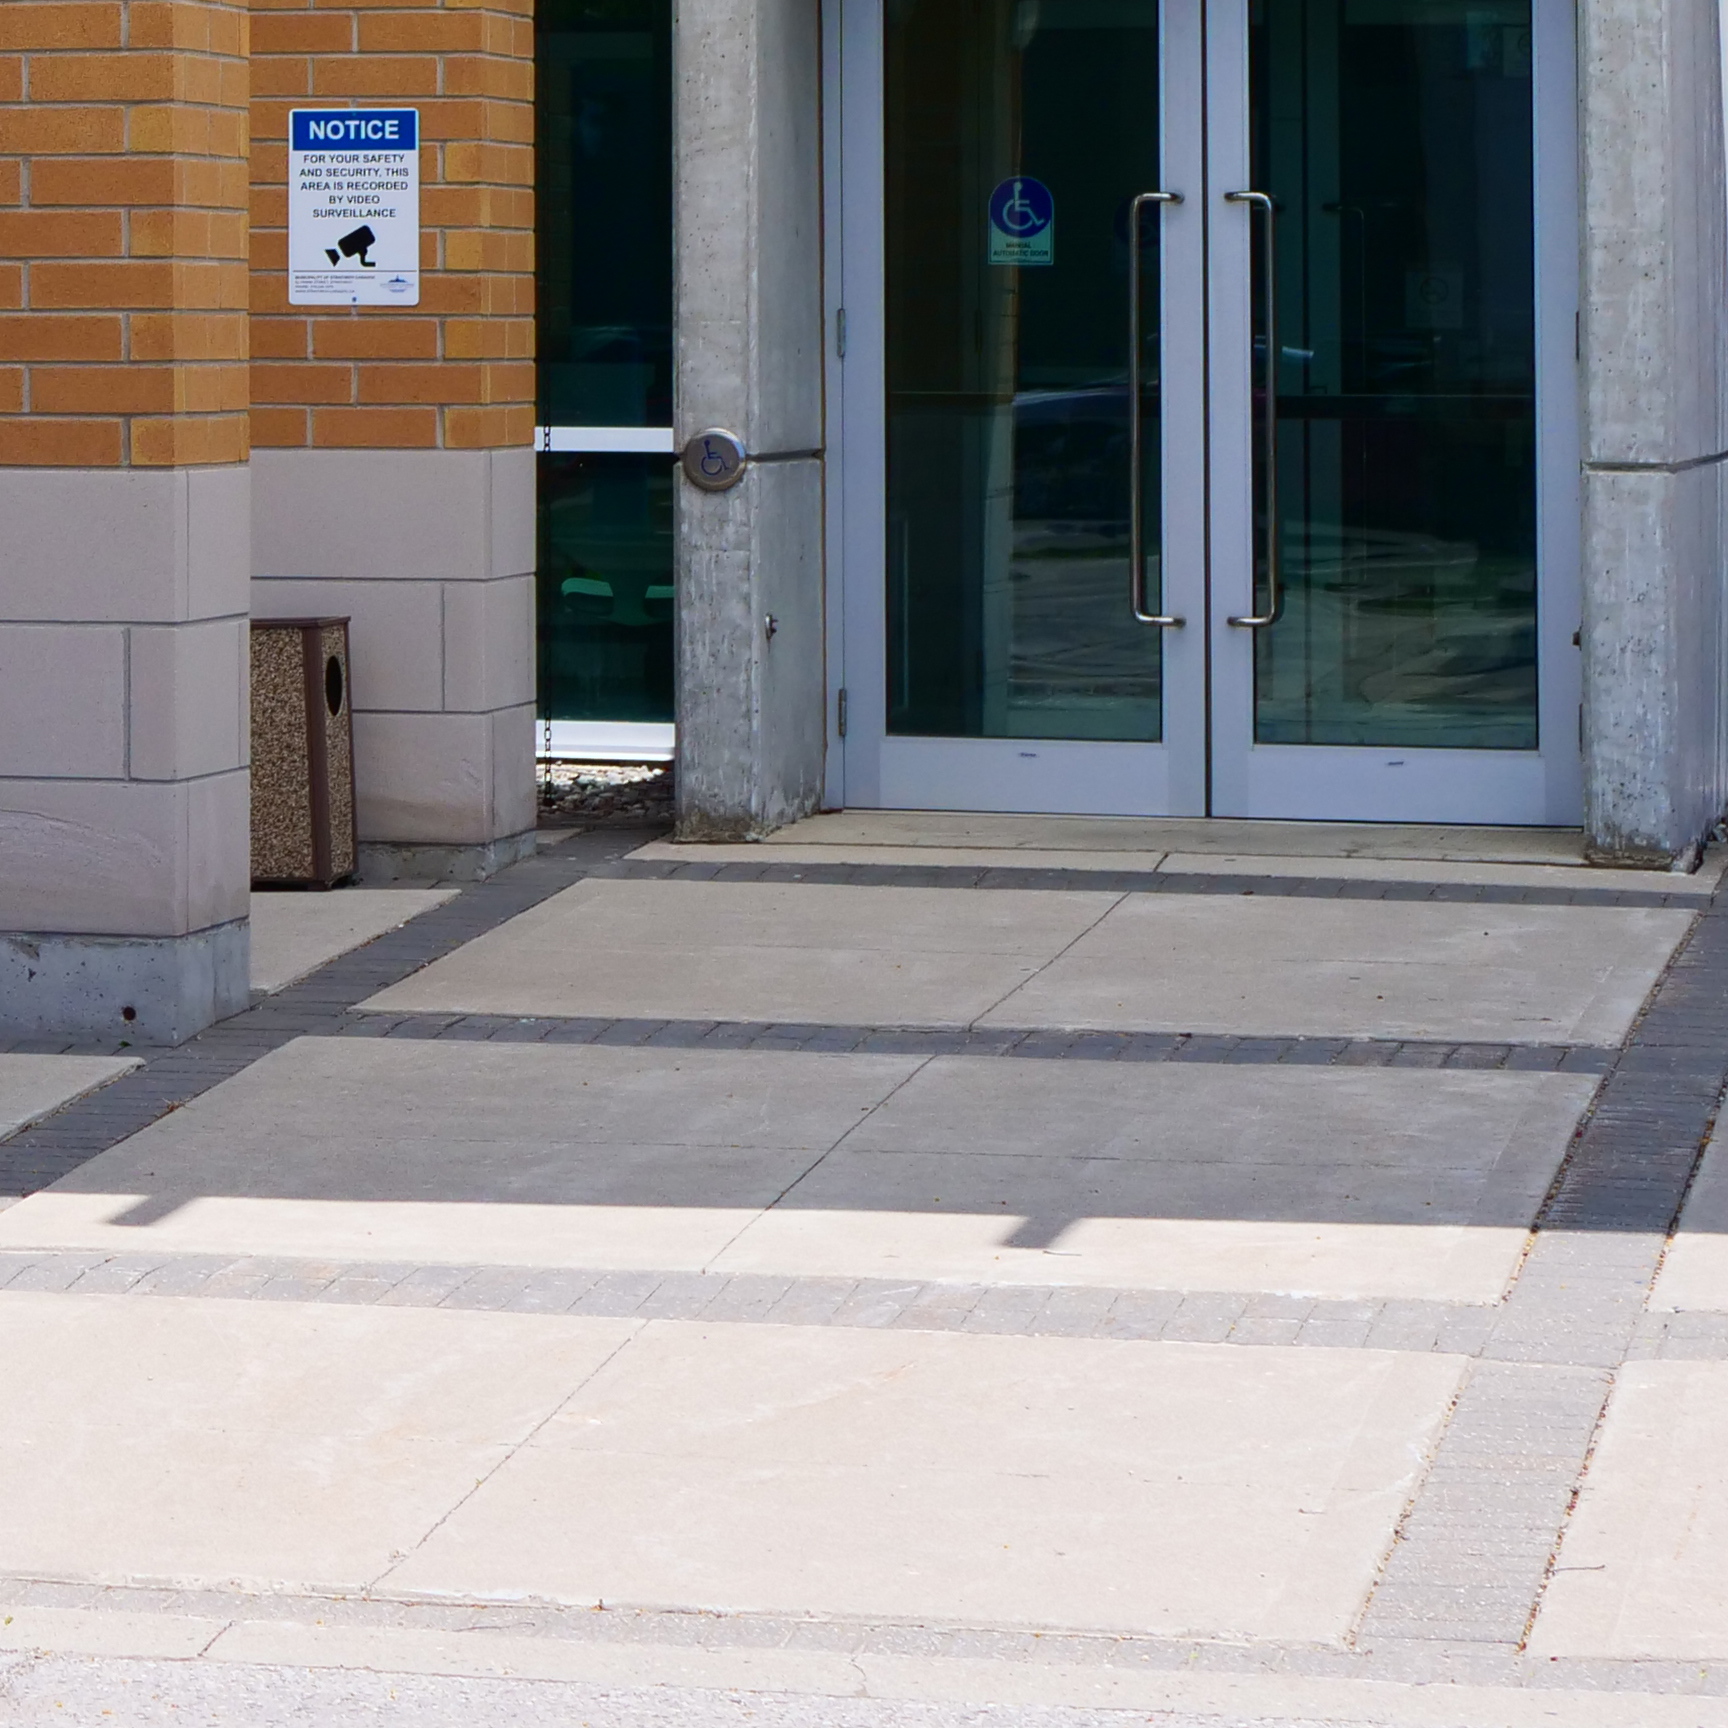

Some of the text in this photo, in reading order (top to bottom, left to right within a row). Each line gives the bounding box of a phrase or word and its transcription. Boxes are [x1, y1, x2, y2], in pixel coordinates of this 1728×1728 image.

[308, 119, 400, 140] NOTICE
[303, 154, 405, 164] FOR YOUR SAFETY
[299, 168, 410, 179] AND SECURITY, THIS
[300, 181, 409, 191] AREA IS RECORDED
[328, 195, 380, 205] BY VIDEO
[312, 208, 397, 218] SURVEILLANCE
